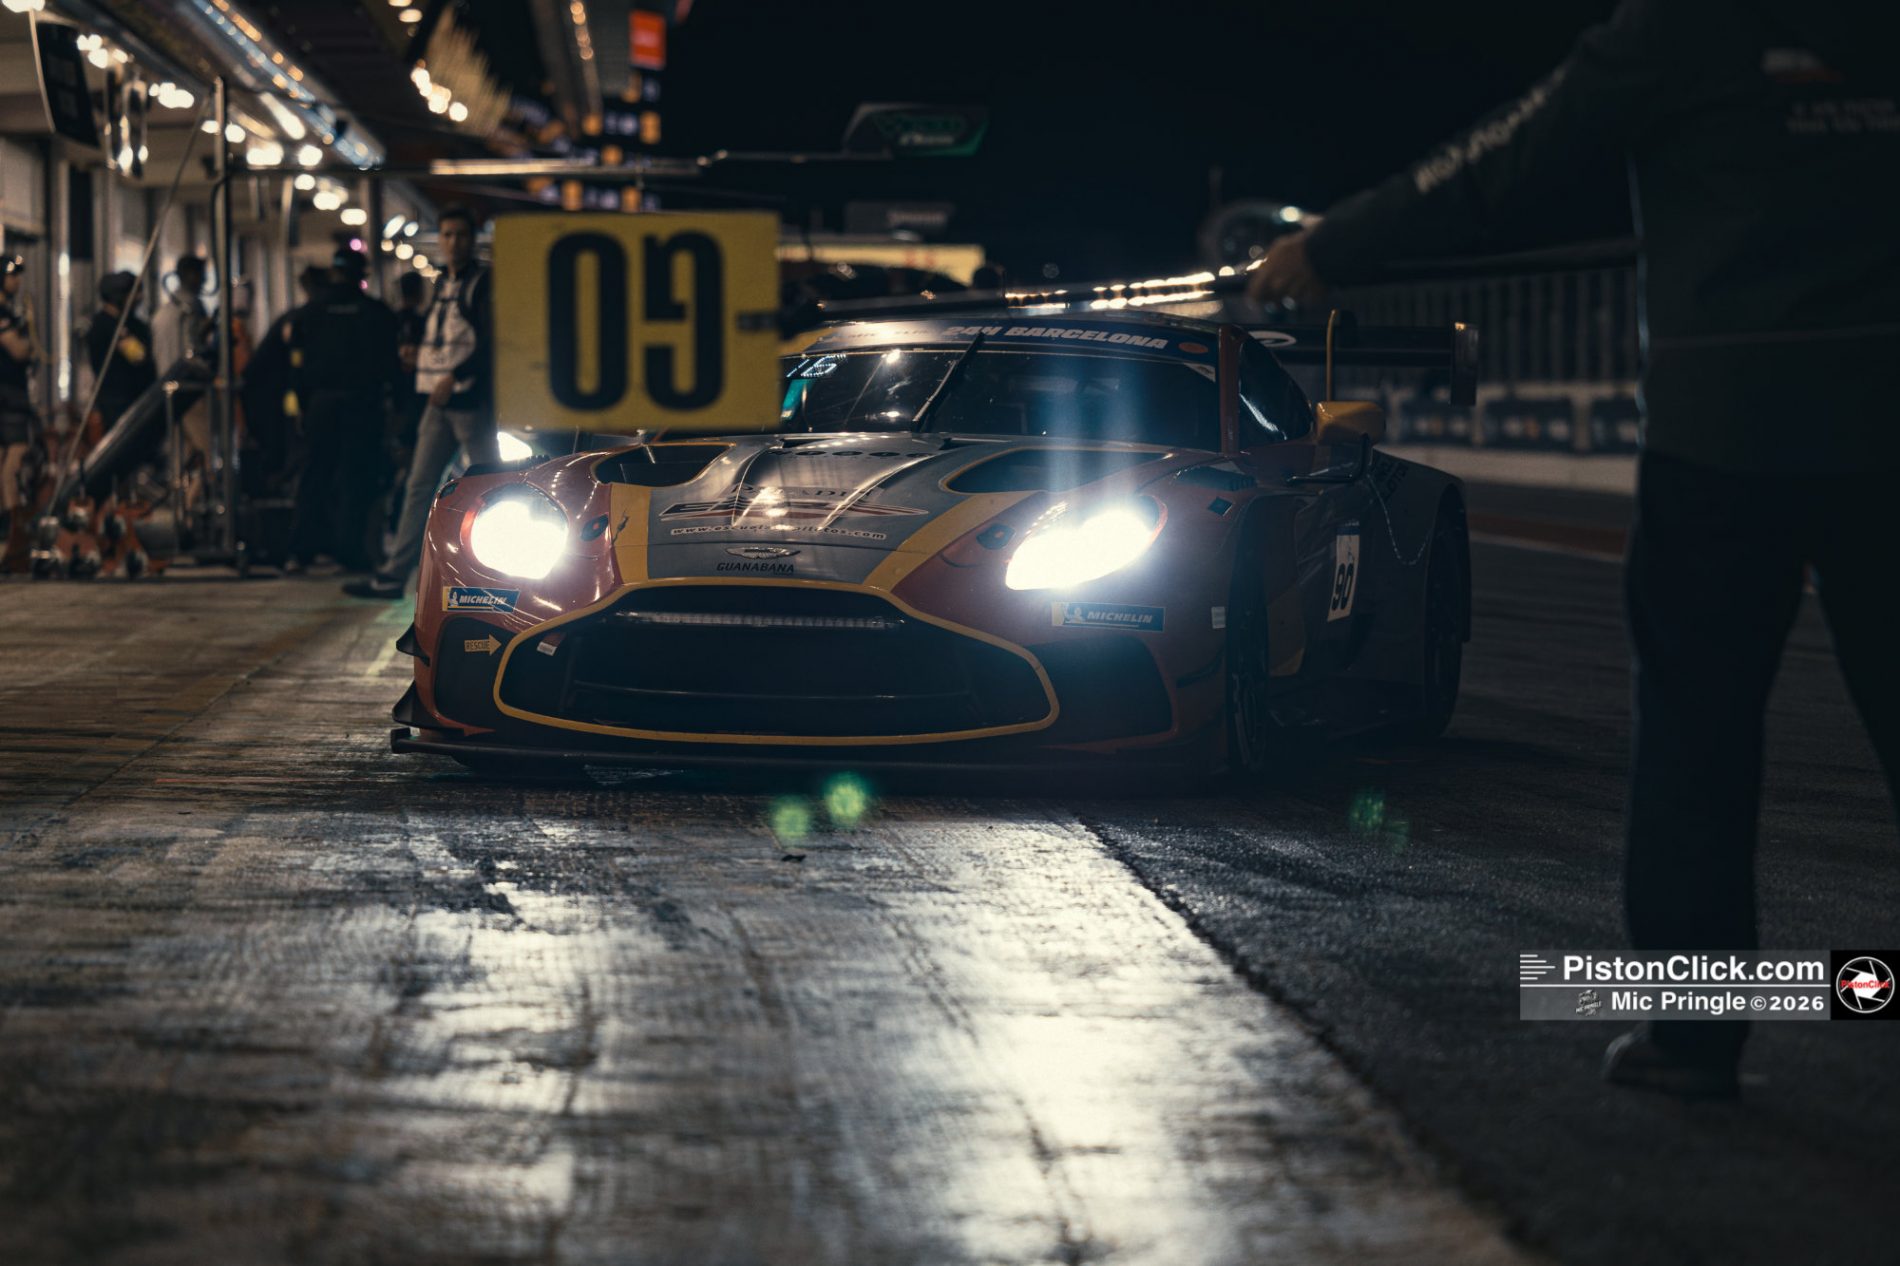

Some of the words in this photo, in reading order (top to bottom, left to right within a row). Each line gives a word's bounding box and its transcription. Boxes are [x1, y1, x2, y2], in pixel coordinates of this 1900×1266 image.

[1004, 326, 1168, 349] BARCELONA
[716, 562, 794, 573] GUANABANA
[1331, 563, 1354, 610] 90
[459, 594, 508, 605] MICHELIN
[1086, 611, 1153, 624] MICHELIN
[465, 641, 490, 652] RESCUE
